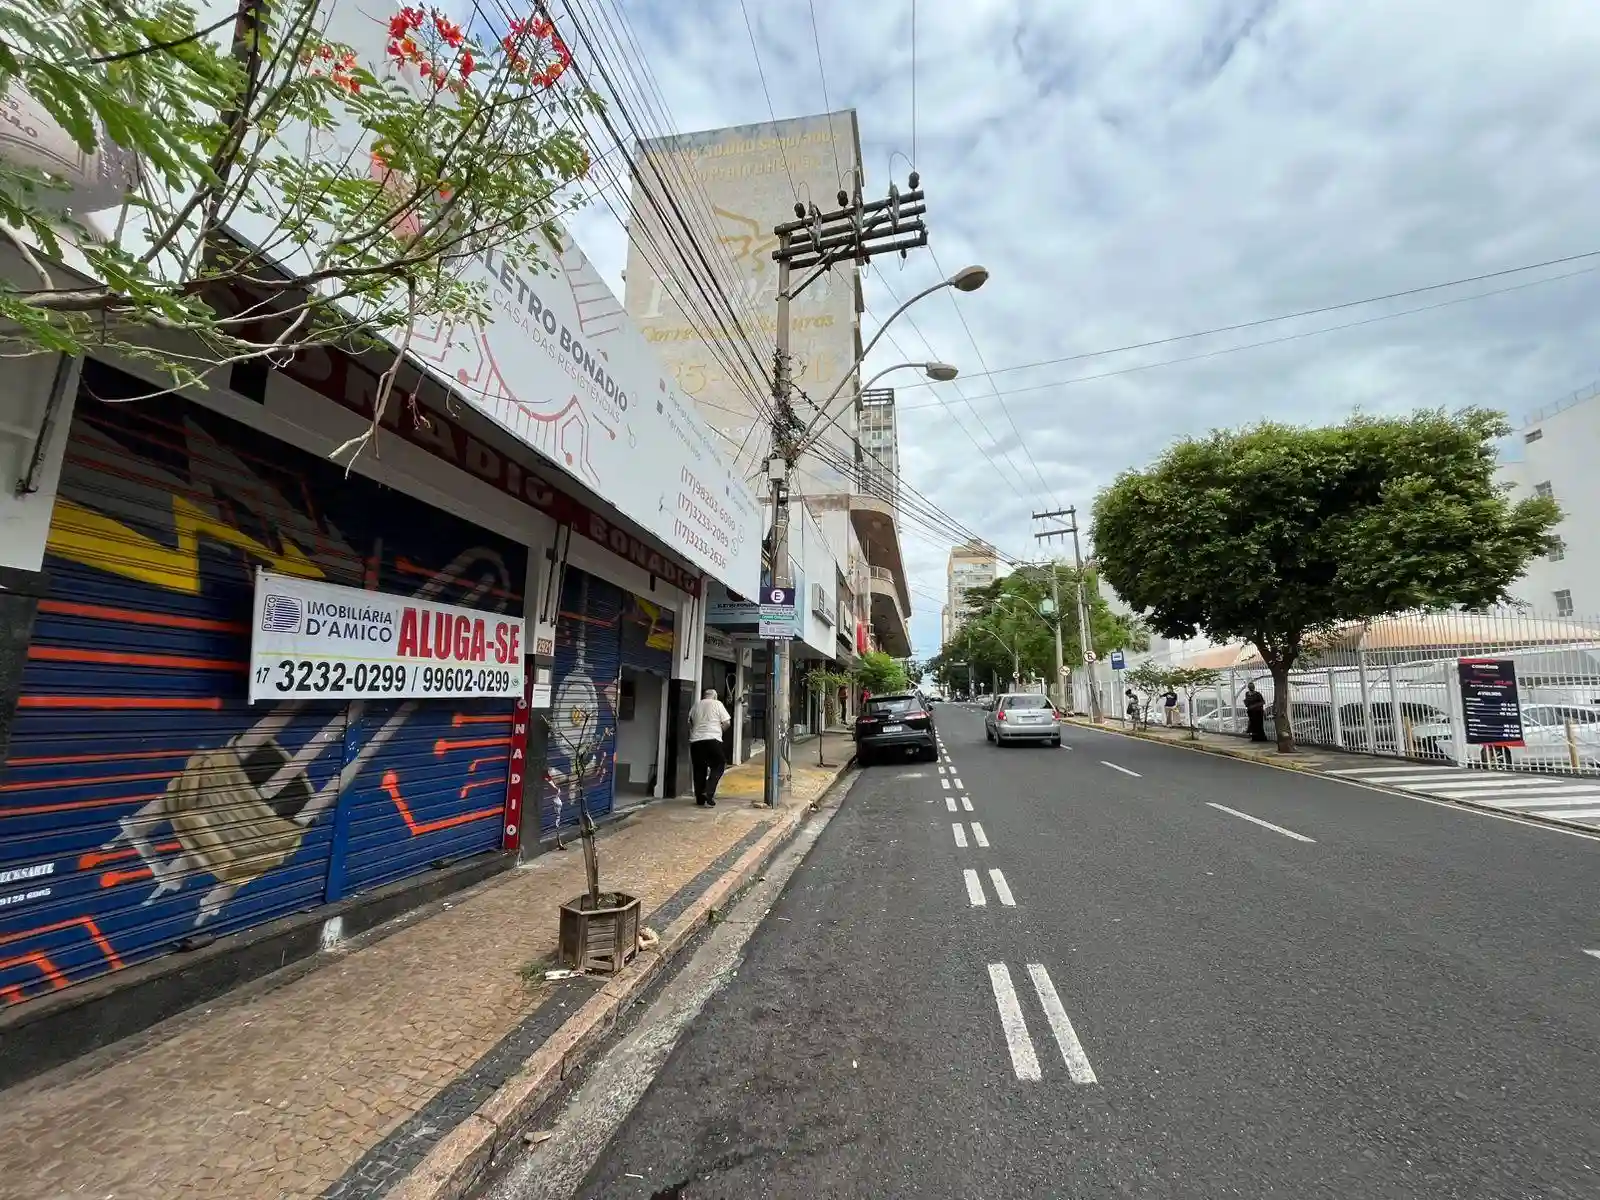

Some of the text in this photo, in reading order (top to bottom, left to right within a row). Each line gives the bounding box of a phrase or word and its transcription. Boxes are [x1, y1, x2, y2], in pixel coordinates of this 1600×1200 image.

[493, 288, 530, 336] CASA
[532, 328, 556, 359] DAS
[557, 353, 621, 424] RESISTÊNCIAS
[559, 324, 628, 412] BONADIO
[774, 592, 782, 601] E
[264, 597, 277, 629] D'AMICO
[307, 601, 393, 625] IMOBILIÁRIA
[306, 618, 393, 643] D'AMICO
[397, 606, 520, 665] ALUGA-SE
[256, 667, 270, 684] 17
[275, 660, 406, 692] 3232-0299
[423, 666, 510, 693] 99602-0299
